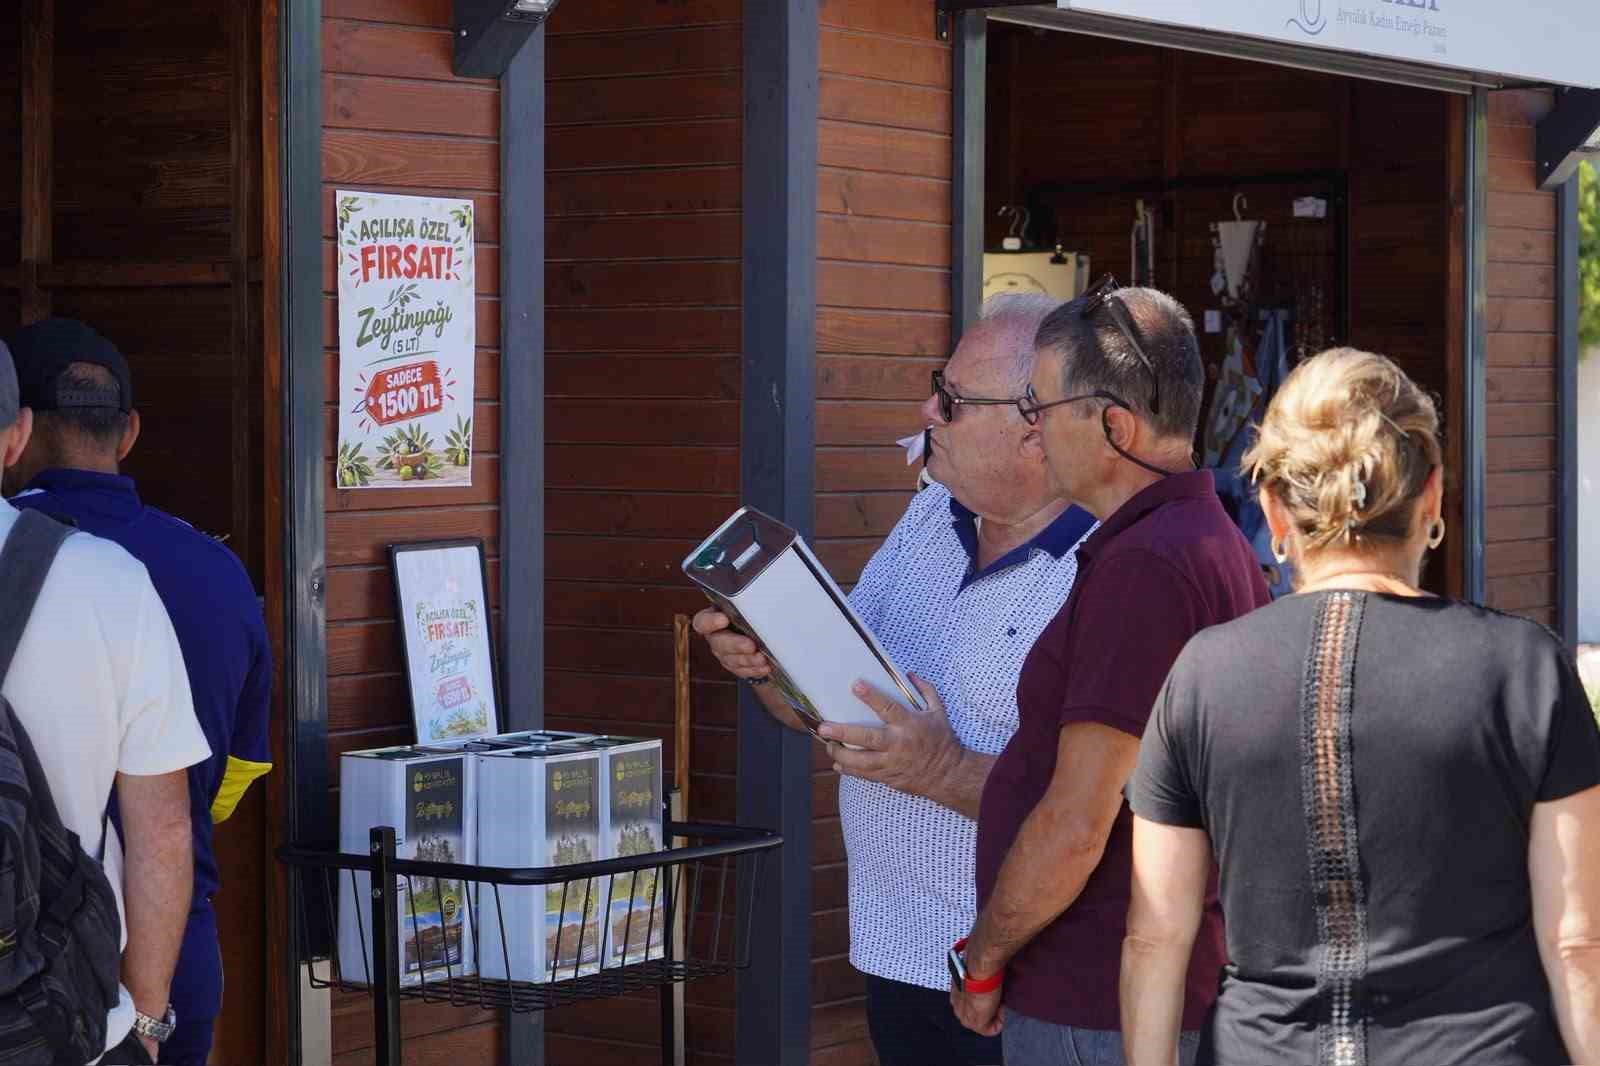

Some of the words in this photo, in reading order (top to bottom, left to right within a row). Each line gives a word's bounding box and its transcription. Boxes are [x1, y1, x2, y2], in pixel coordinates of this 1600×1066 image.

[360, 218, 415, 243] AÇILIŞA
[420, 217, 451, 242] ÖZEL
[361, 244, 453, 283] FIRSAT!
[356, 300, 453, 350] Zeytinyağı
[393, 339, 403, 354] (5
[406, 337, 419, 351] LT)
[386, 367, 423, 388] SADECE
[378, 386, 418, 418] 1500
[420, 383, 440, 408] TL
[427, 621, 469, 641] FIRSAT!
